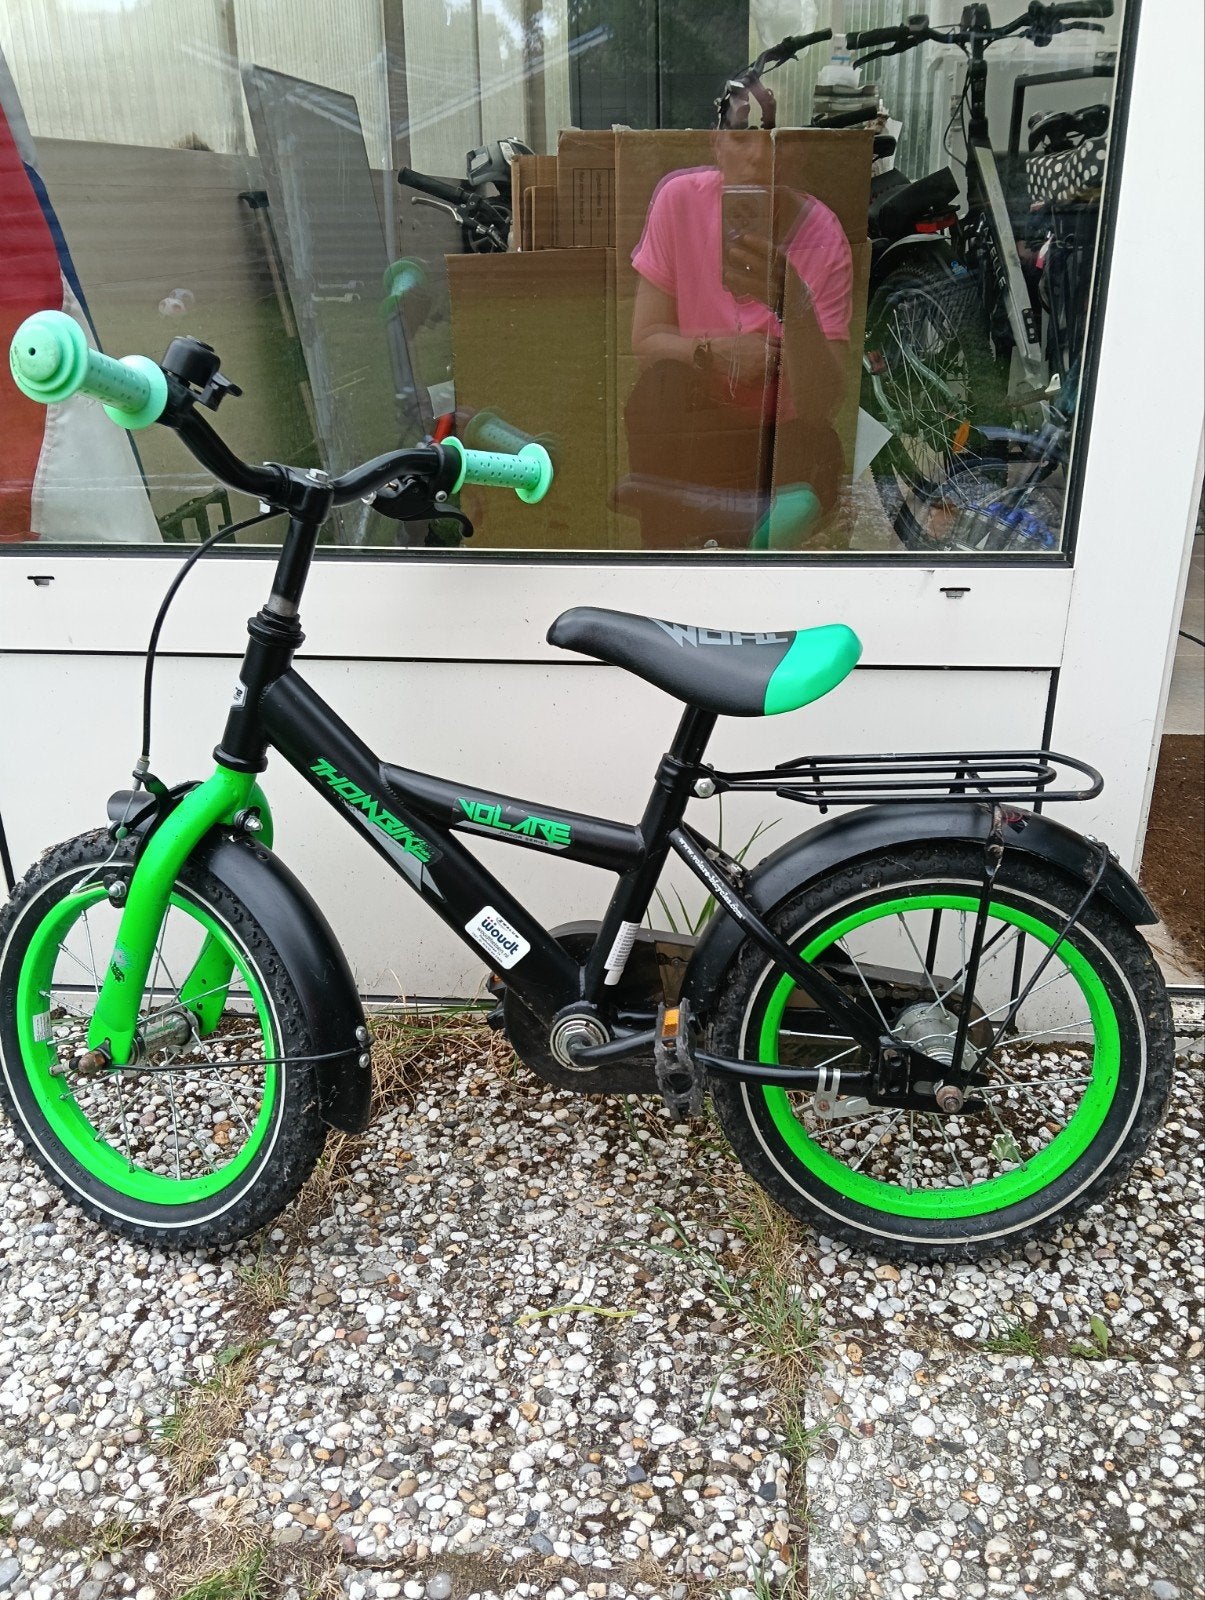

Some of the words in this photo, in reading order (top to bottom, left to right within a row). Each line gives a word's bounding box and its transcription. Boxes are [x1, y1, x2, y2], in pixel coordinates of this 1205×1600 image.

[310, 758, 431, 863] THOMBIKE
[458, 796, 573, 851] VOLARE
[482, 916, 520, 955] woudt
